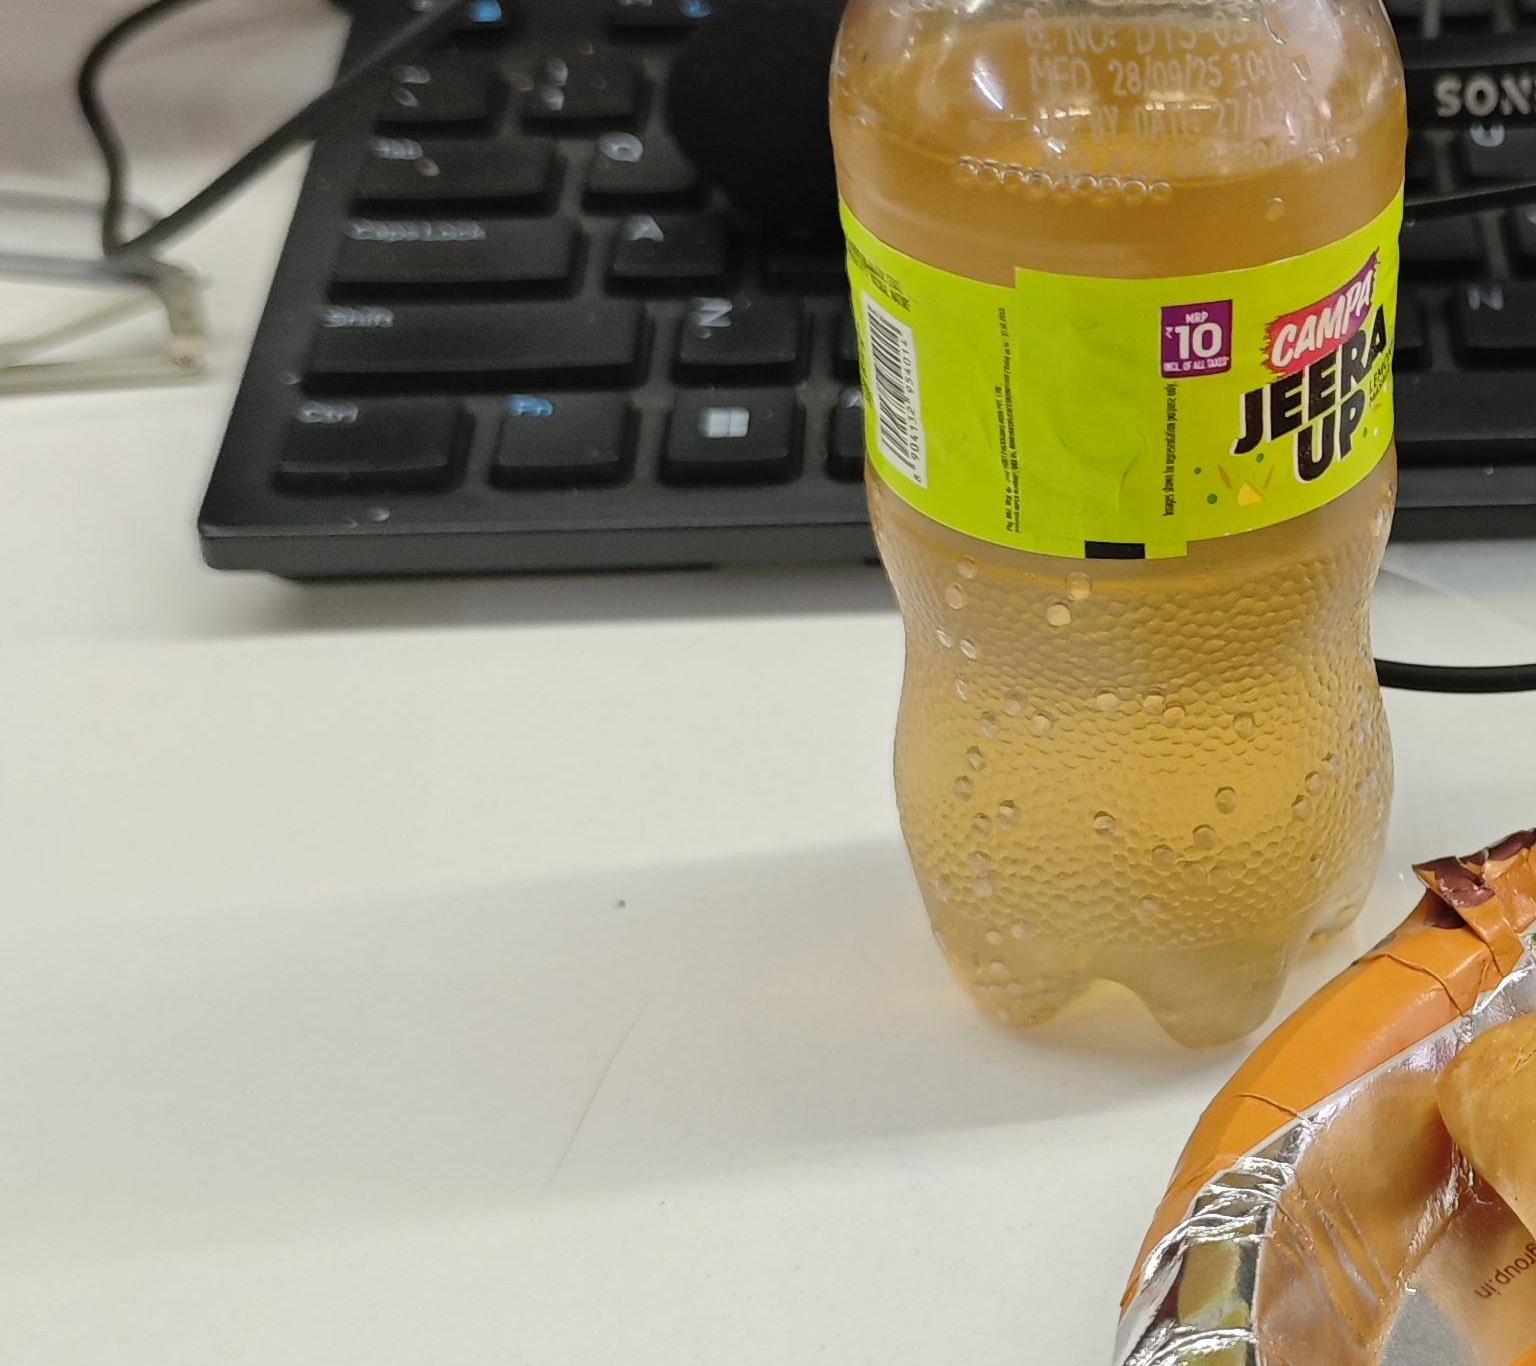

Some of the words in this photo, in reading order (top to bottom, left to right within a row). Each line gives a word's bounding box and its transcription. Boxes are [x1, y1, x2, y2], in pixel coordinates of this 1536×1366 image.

[1271, 269, 1374, 368] CAMPA
[1231, 303, 1387, 455] JEERA
[1294, 388, 1366, 483] UP
